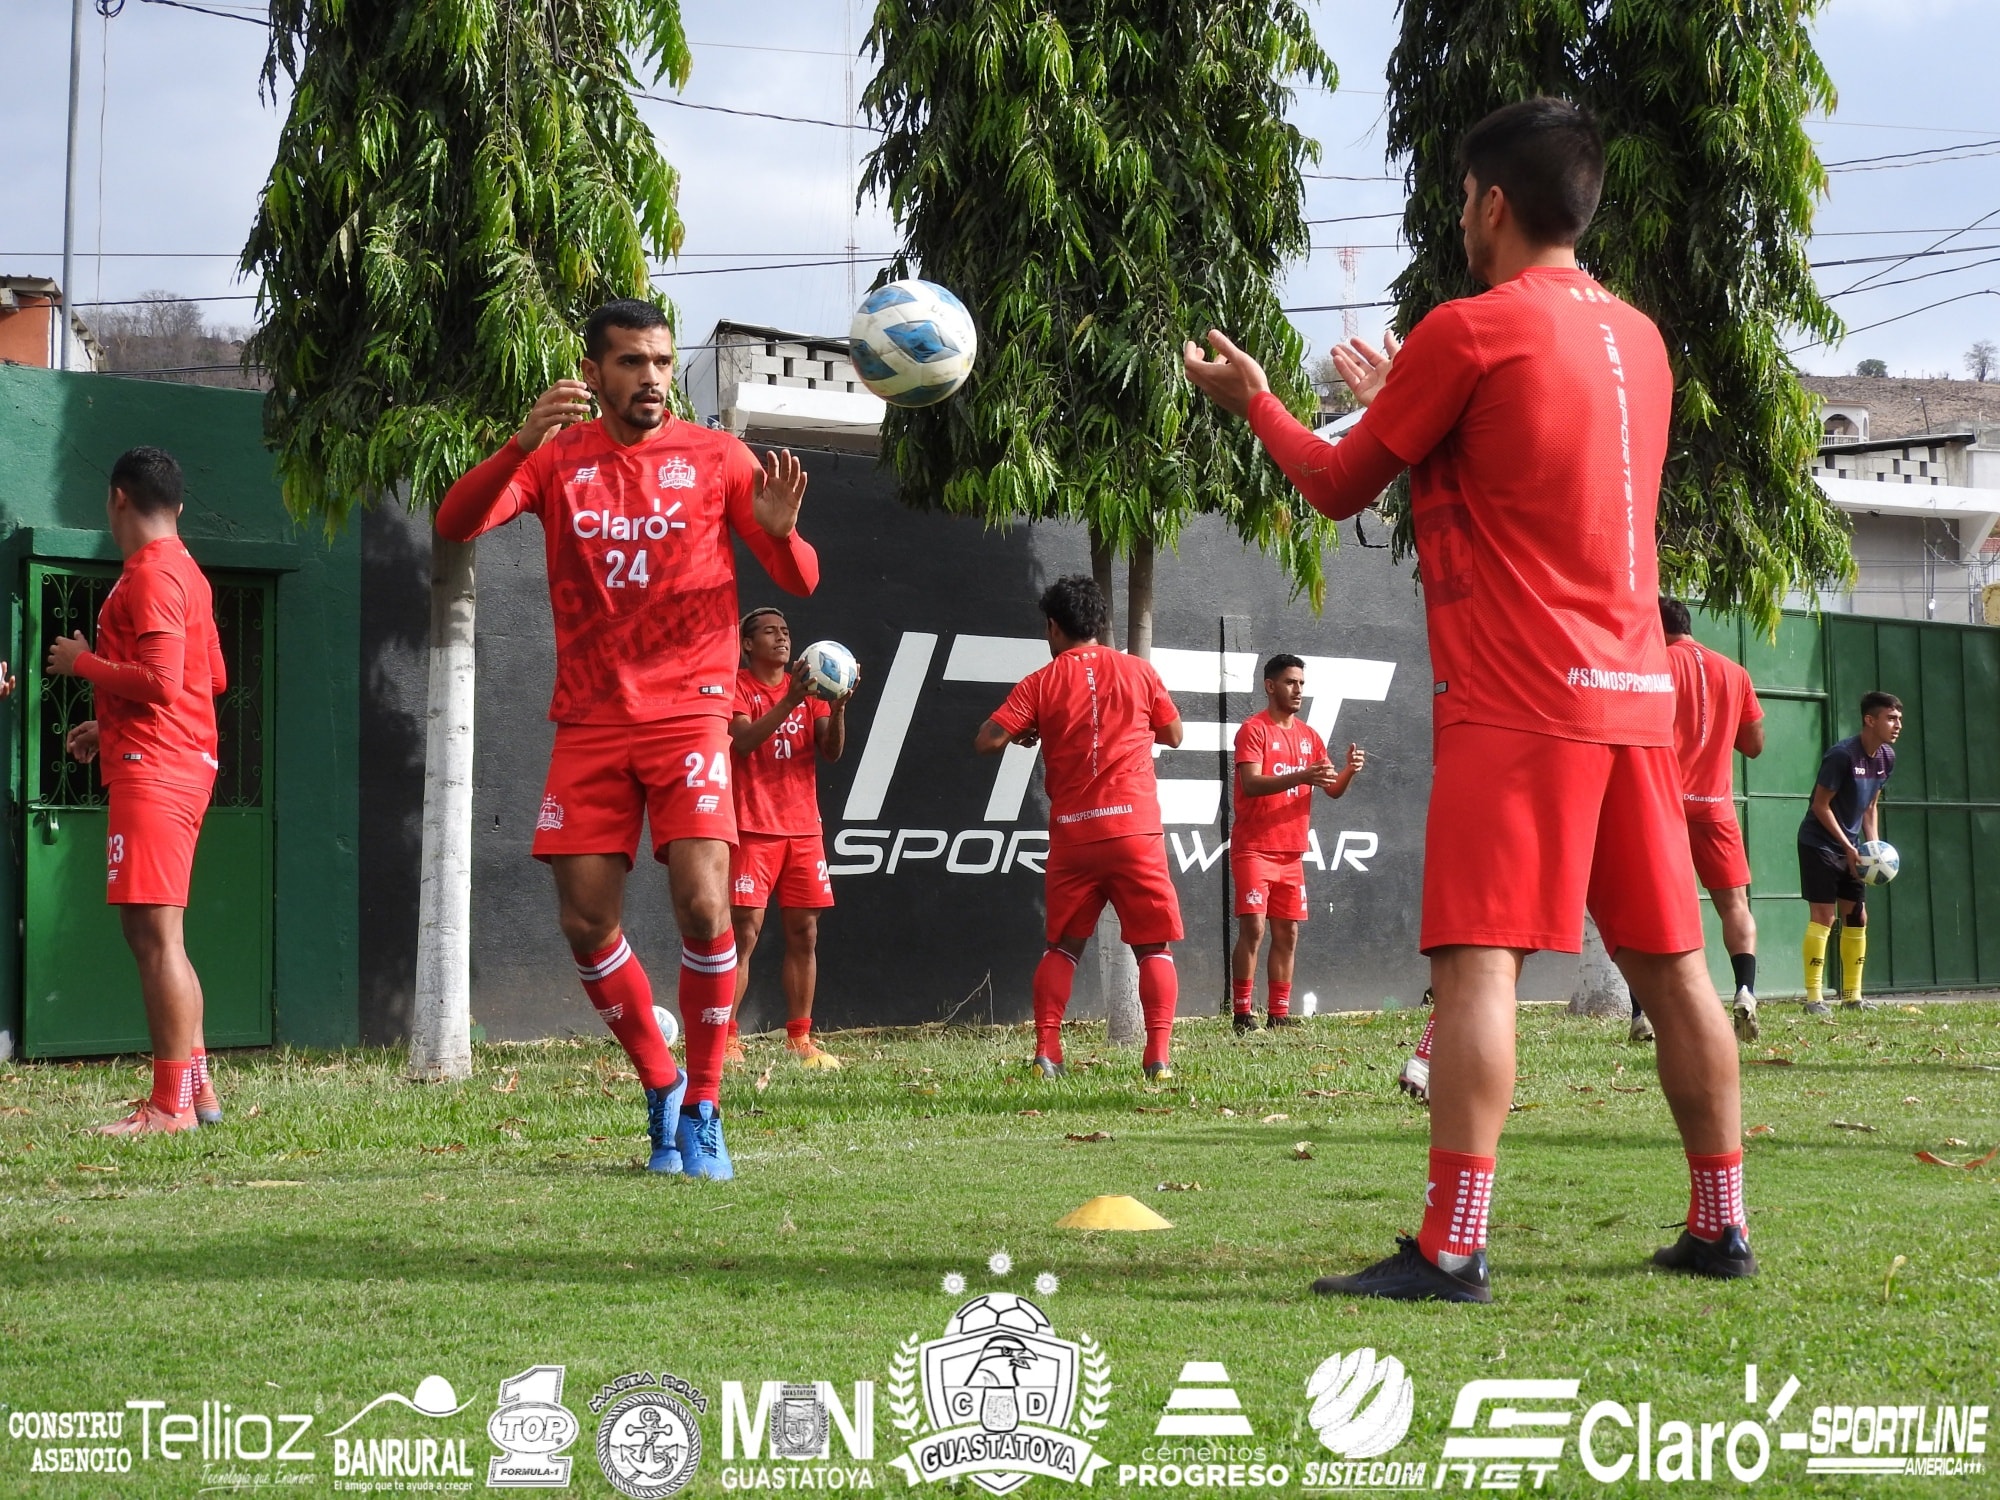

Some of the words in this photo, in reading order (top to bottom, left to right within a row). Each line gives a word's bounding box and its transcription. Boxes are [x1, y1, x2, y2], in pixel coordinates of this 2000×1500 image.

[572, 508, 669, 541] Claro
[605, 549, 650, 589] 24
[774, 738, 792, 759] 20
[684, 752, 729, 790] 24
